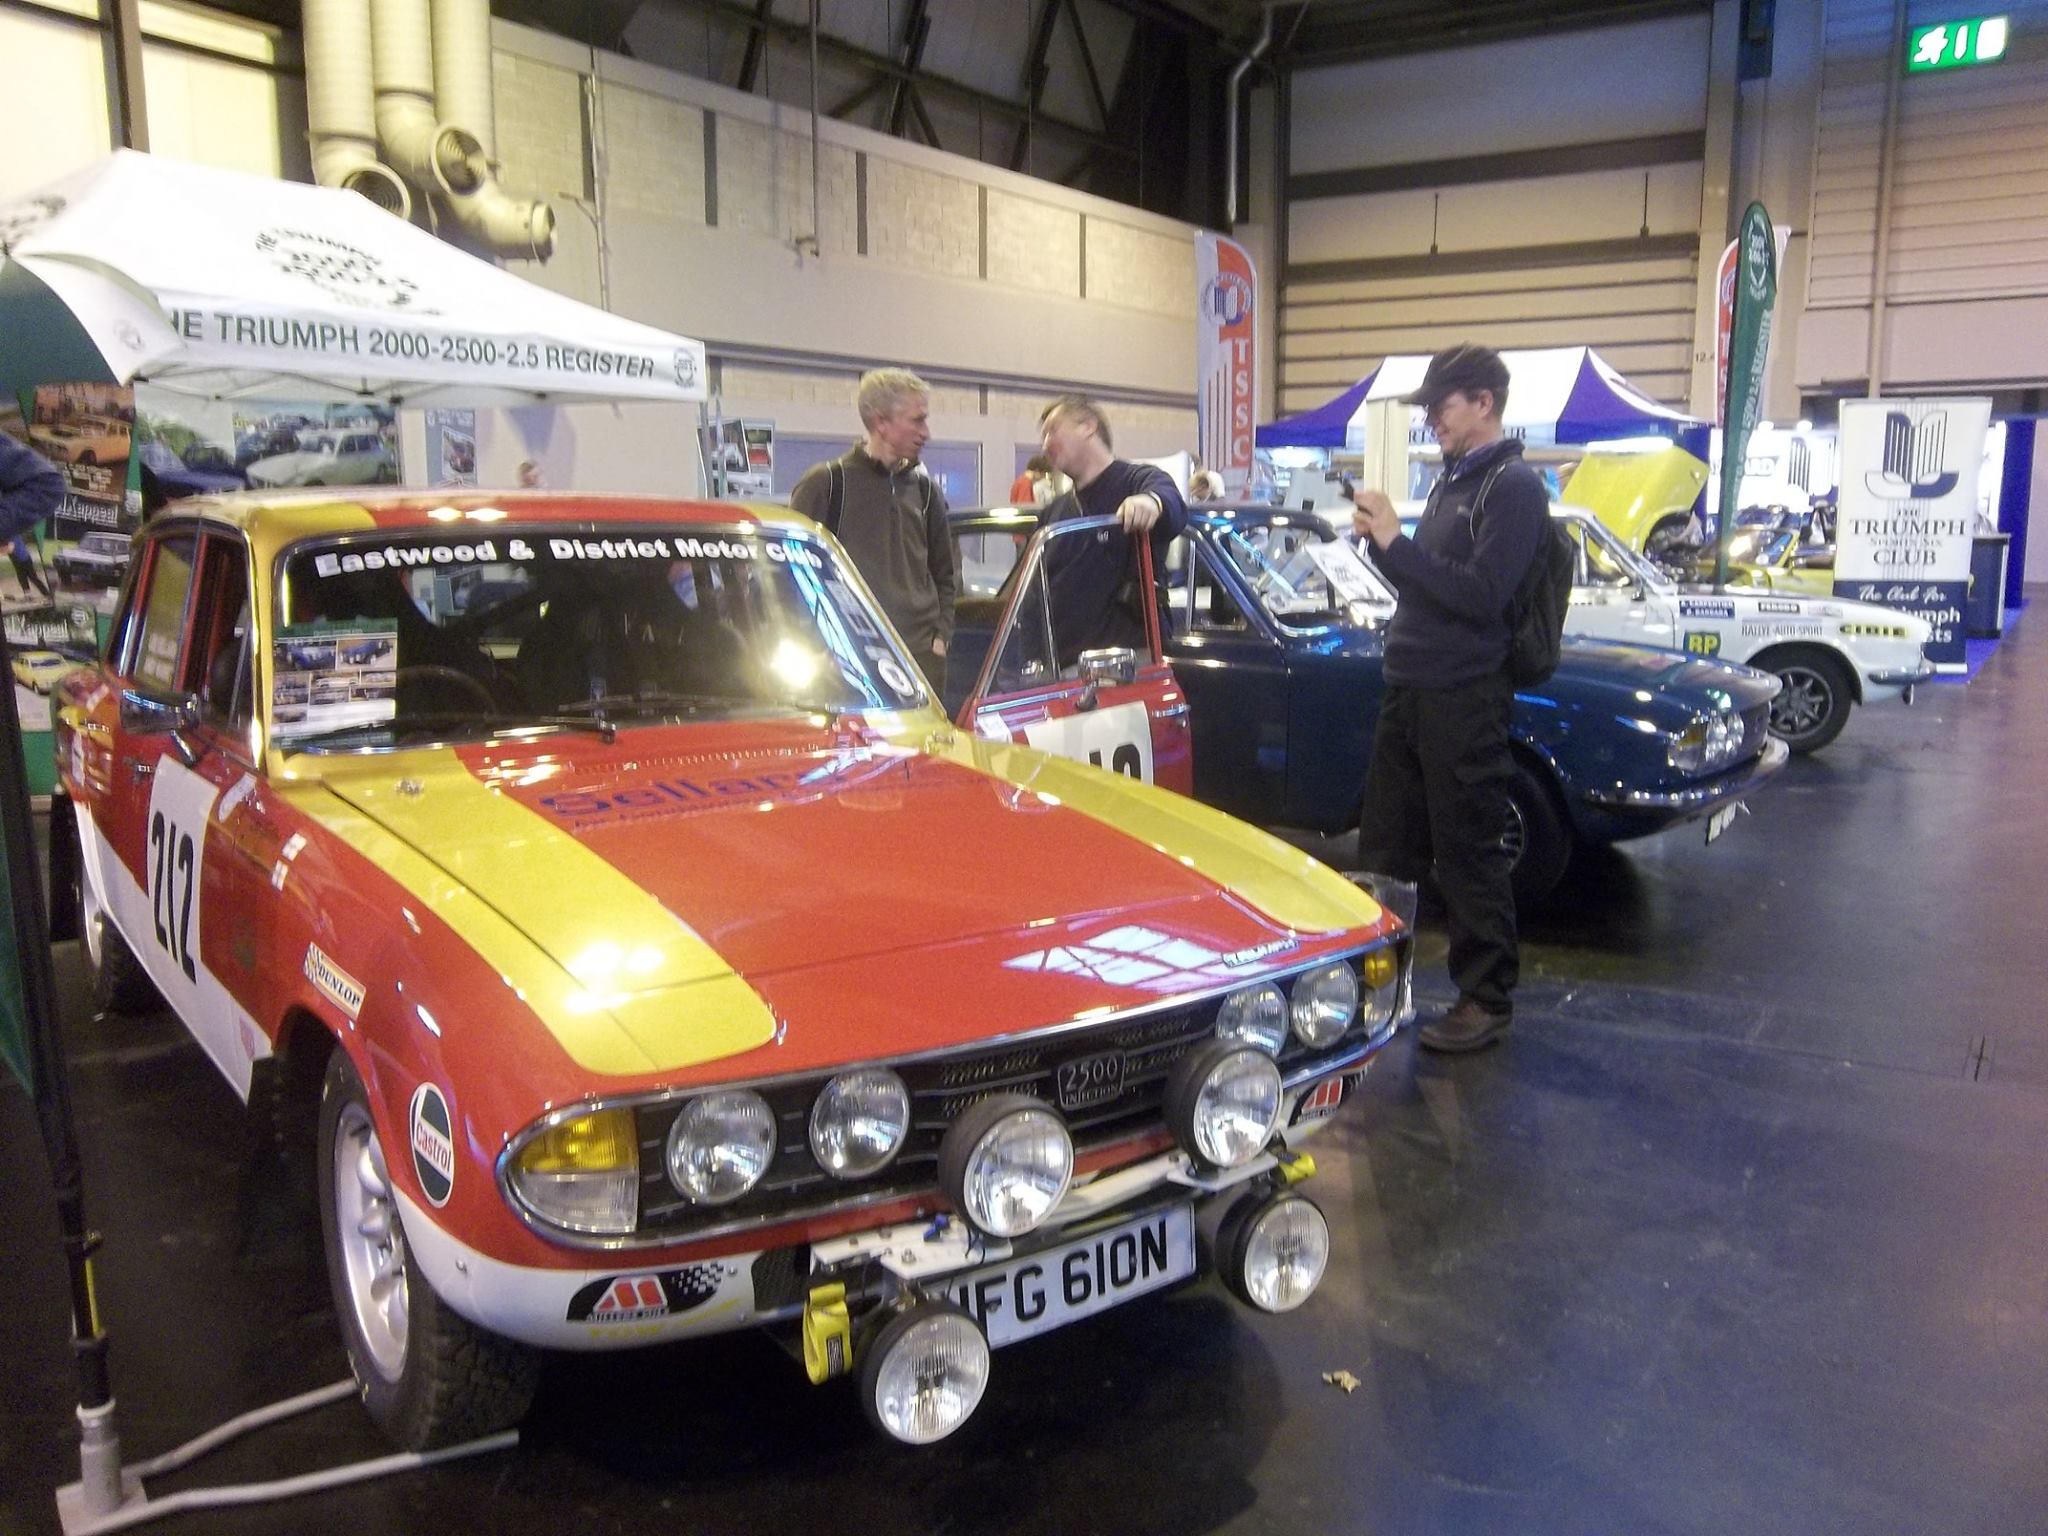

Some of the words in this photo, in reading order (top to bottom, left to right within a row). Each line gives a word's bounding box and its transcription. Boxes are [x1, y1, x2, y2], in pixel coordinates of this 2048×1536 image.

[214, 313, 359, 351] TRIUMPH
[369, 329, 538, 368] 2000-2500-2.5
[546, 346, 655, 378] REGISTER
[1233, 337, 1250, 461] TSSC
[1850, 519, 1966, 536] TRIUMPH
[315, 540, 497, 578] Eastwood
[509, 539, 535, 560] &
[550, 538, 671, 559] District
[674, 538, 758, 559] Motor
[1873, 549, 1937, 566] CLUB
[1859, 584, 1882, 602] The
[1887, 584, 1920, 602] Club
[152, 811, 197, 985] 212
[318, 964, 361, 1007] DUNLOP
[1065, 1056, 1118, 1092] 2500
[416, 1123, 451, 1172] Castrol
[1062, 1218, 1167, 1305] 610N
